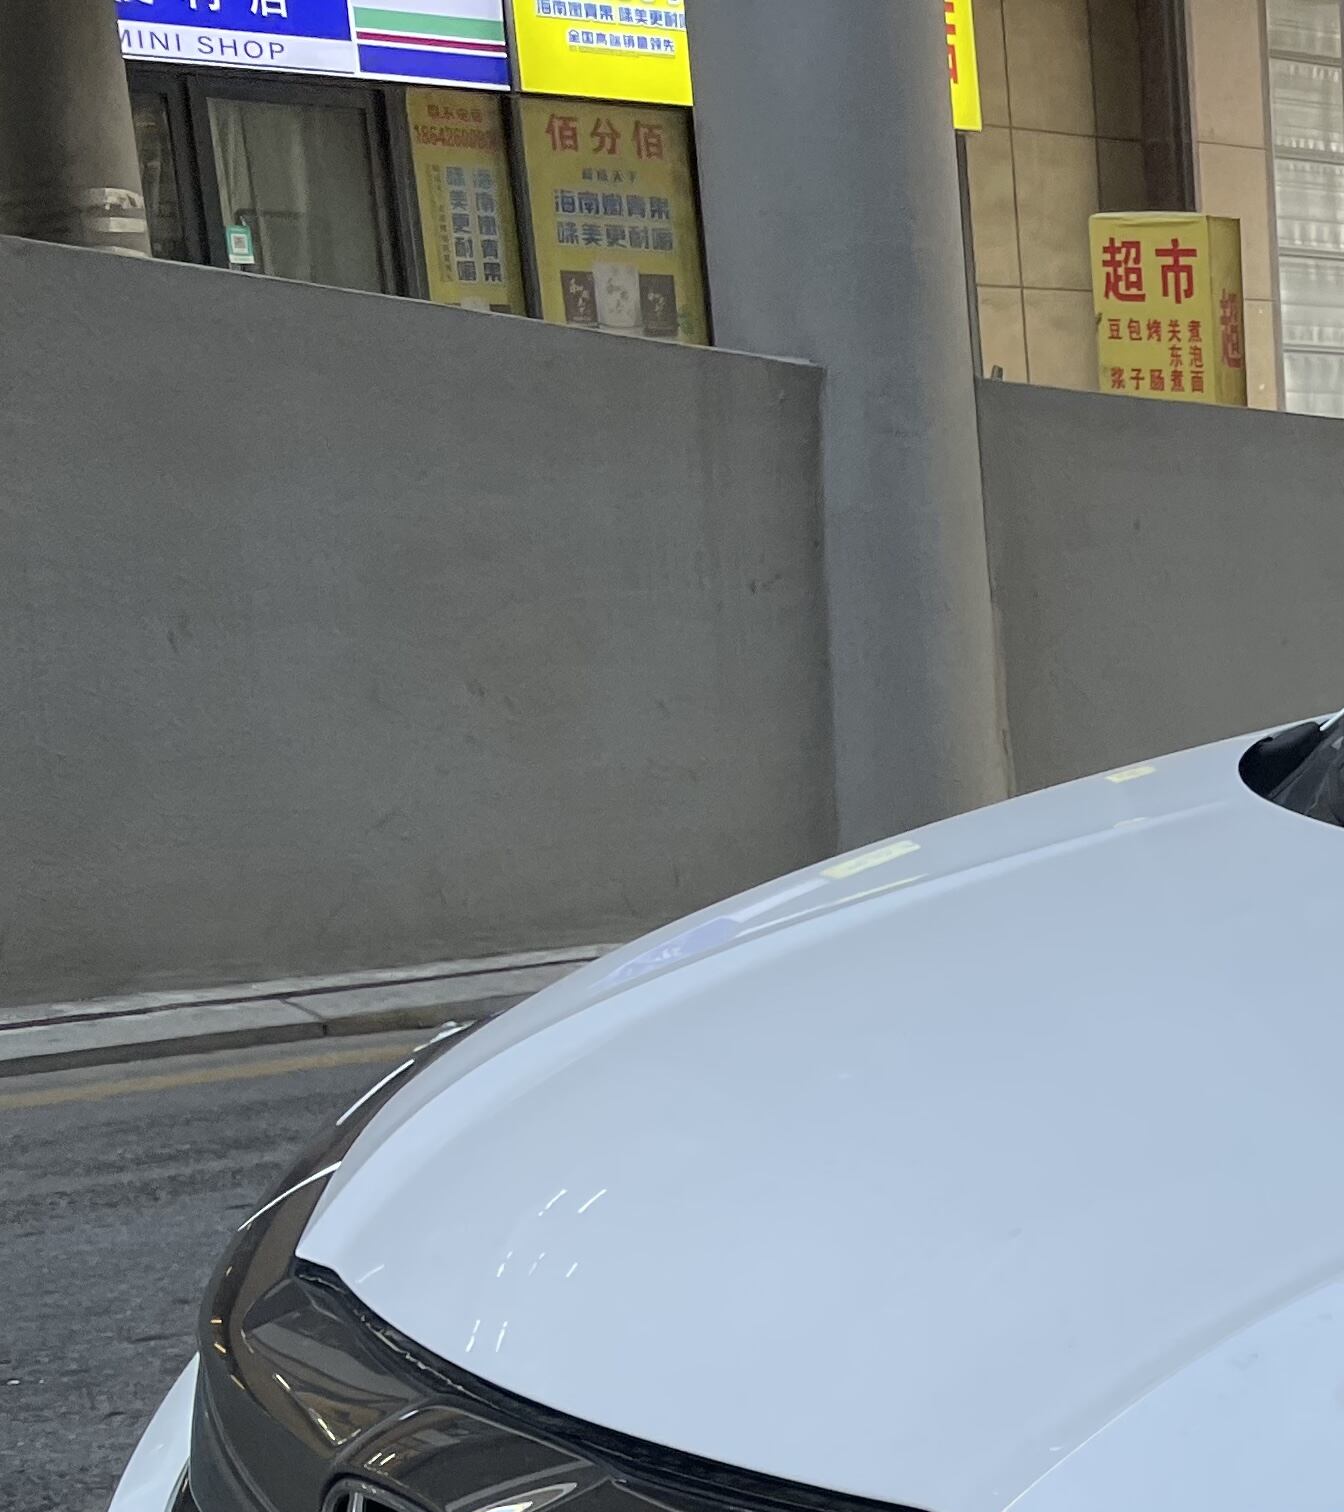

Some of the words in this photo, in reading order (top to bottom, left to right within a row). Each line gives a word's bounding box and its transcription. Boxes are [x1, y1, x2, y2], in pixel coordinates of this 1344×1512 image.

[197, 35, 285, 60] SHOP
[545, 113, 663, 160] 佰分佰
[1102, 237, 1197, 305] 超市
